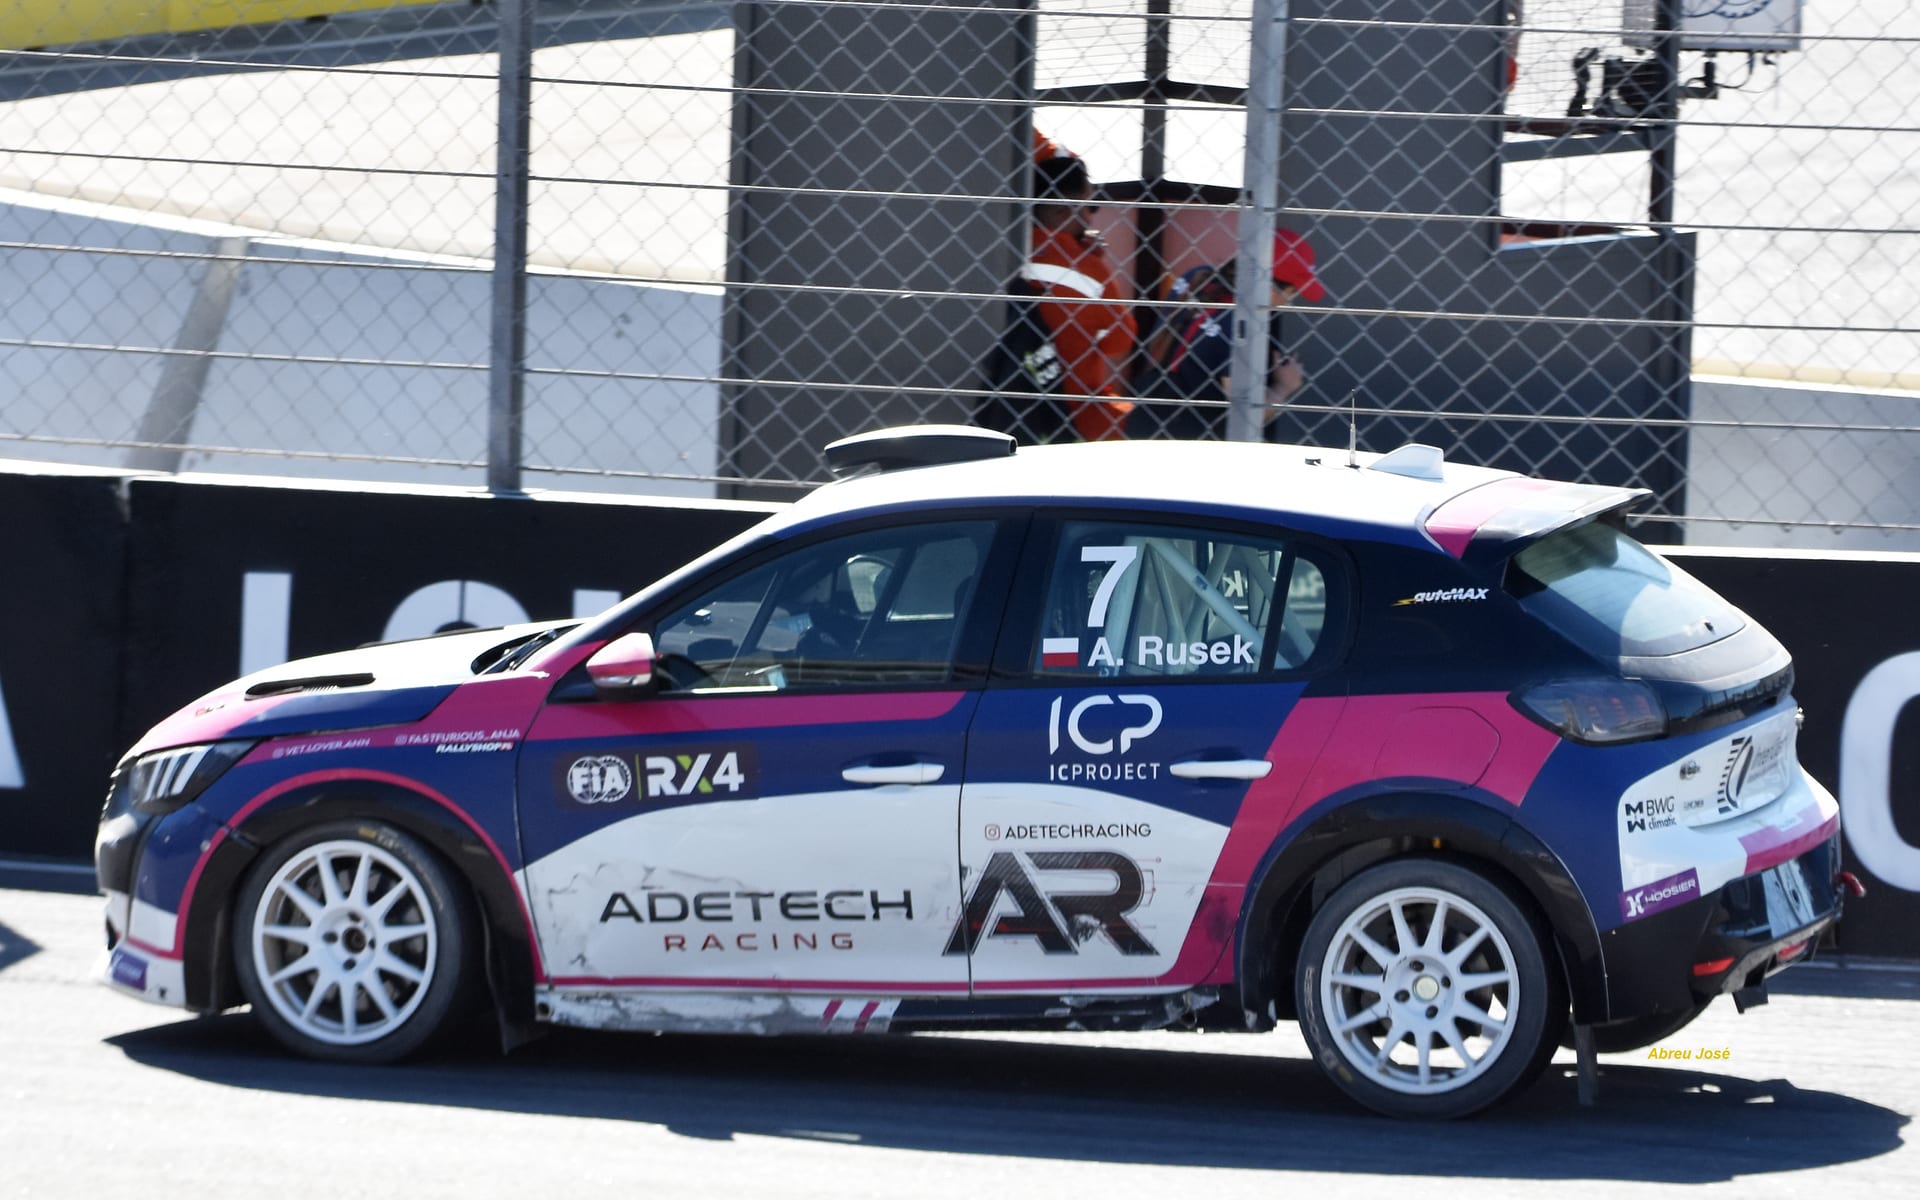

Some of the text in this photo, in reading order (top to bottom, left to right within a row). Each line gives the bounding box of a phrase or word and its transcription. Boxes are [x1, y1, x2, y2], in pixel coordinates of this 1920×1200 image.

[1081, 546, 1137, 627] 7
[1087, 634, 1254, 666] A. Rusek
[1049, 694, 1163, 755] ICP
[646, 752, 744, 796] RX4
[1050, 763, 1161, 781] ICPROJECT
[1646, 796, 1675, 817] BWG
[1005, 824, 1152, 839] ADETECHRACING
[599, 890, 914, 923] ADETECH
[941, 851, 1161, 957] AR
[664, 933, 854, 951] RACING
